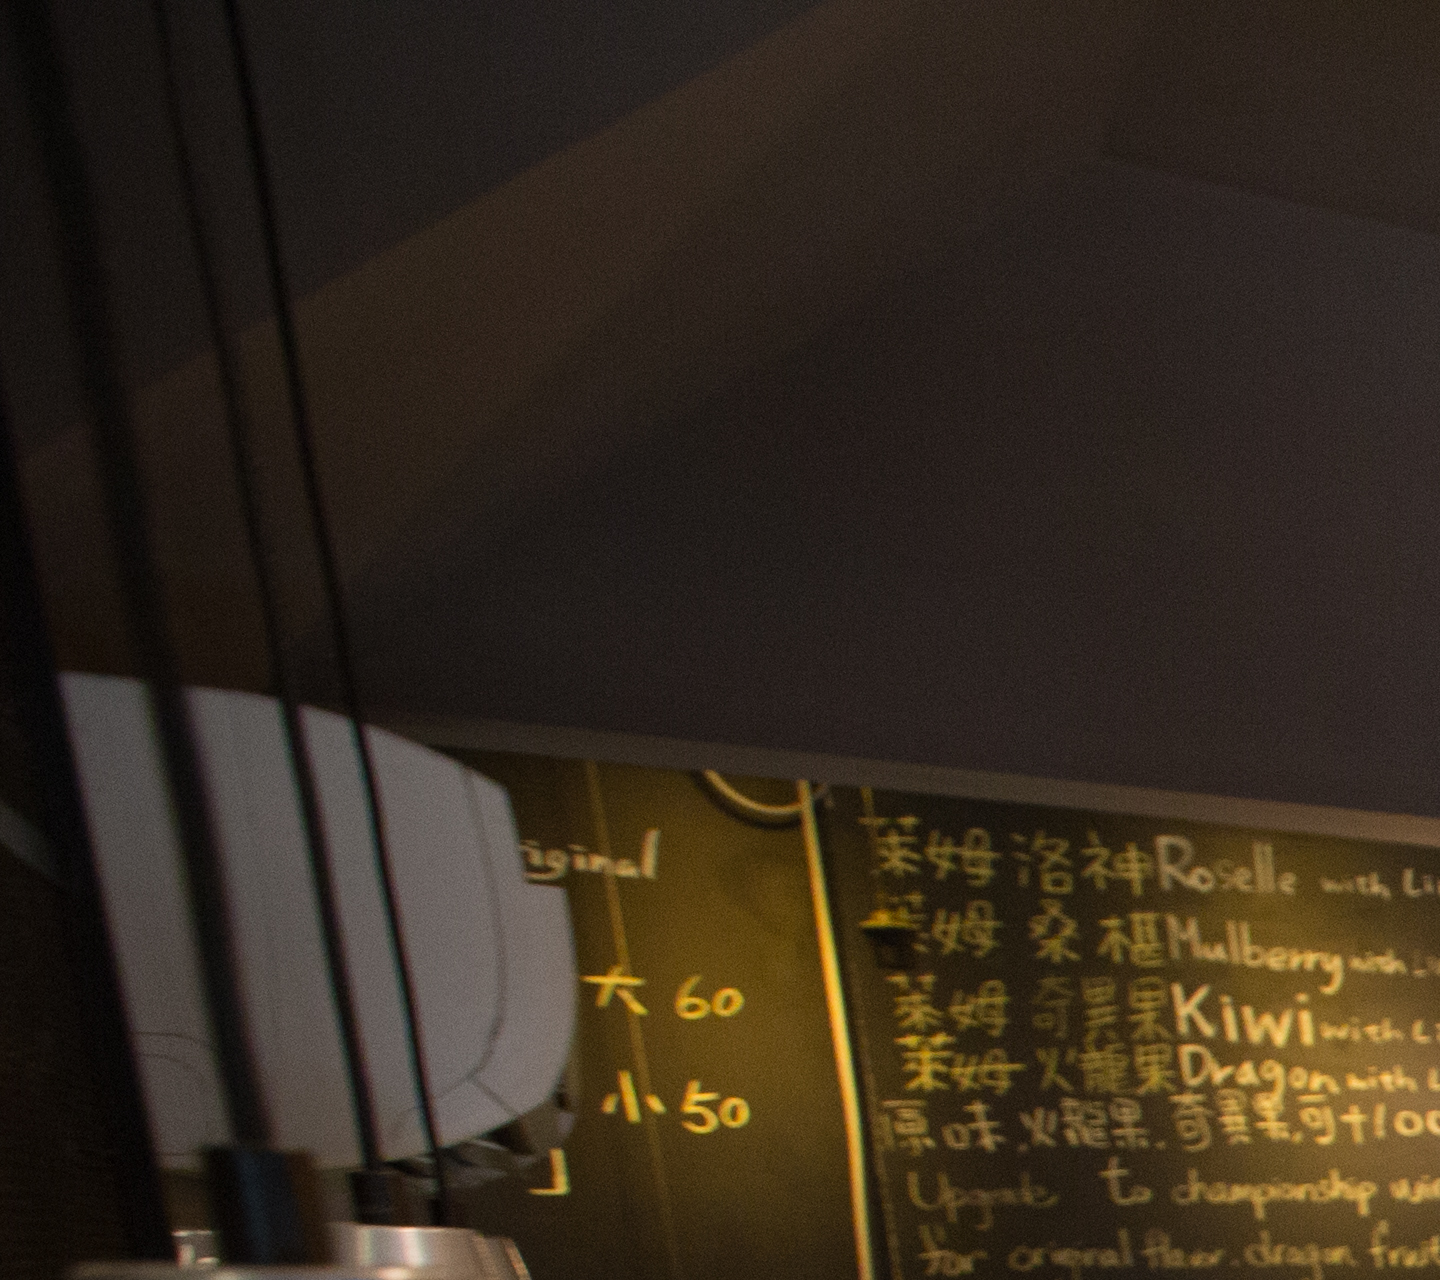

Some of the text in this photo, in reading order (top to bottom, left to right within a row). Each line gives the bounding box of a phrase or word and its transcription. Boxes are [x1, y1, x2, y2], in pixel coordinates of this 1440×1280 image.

[1154, 834, 1298, 896] Roselle
[1320, 871, 1392, 900] with
[1165, 910, 1343, 996] Mulberry
[674, 975, 746, 1021] 60
[1170, 981, 1315, 1048] Kiwi
[1320, 1016, 1403, 1043] with
[602, 1069, 751, 1134] 小 50
[1177, 1043, 1341, 1104] Dragon
[1346, 1063, 1419, 1092] with
[1100, 1155, 1152, 1205] to
